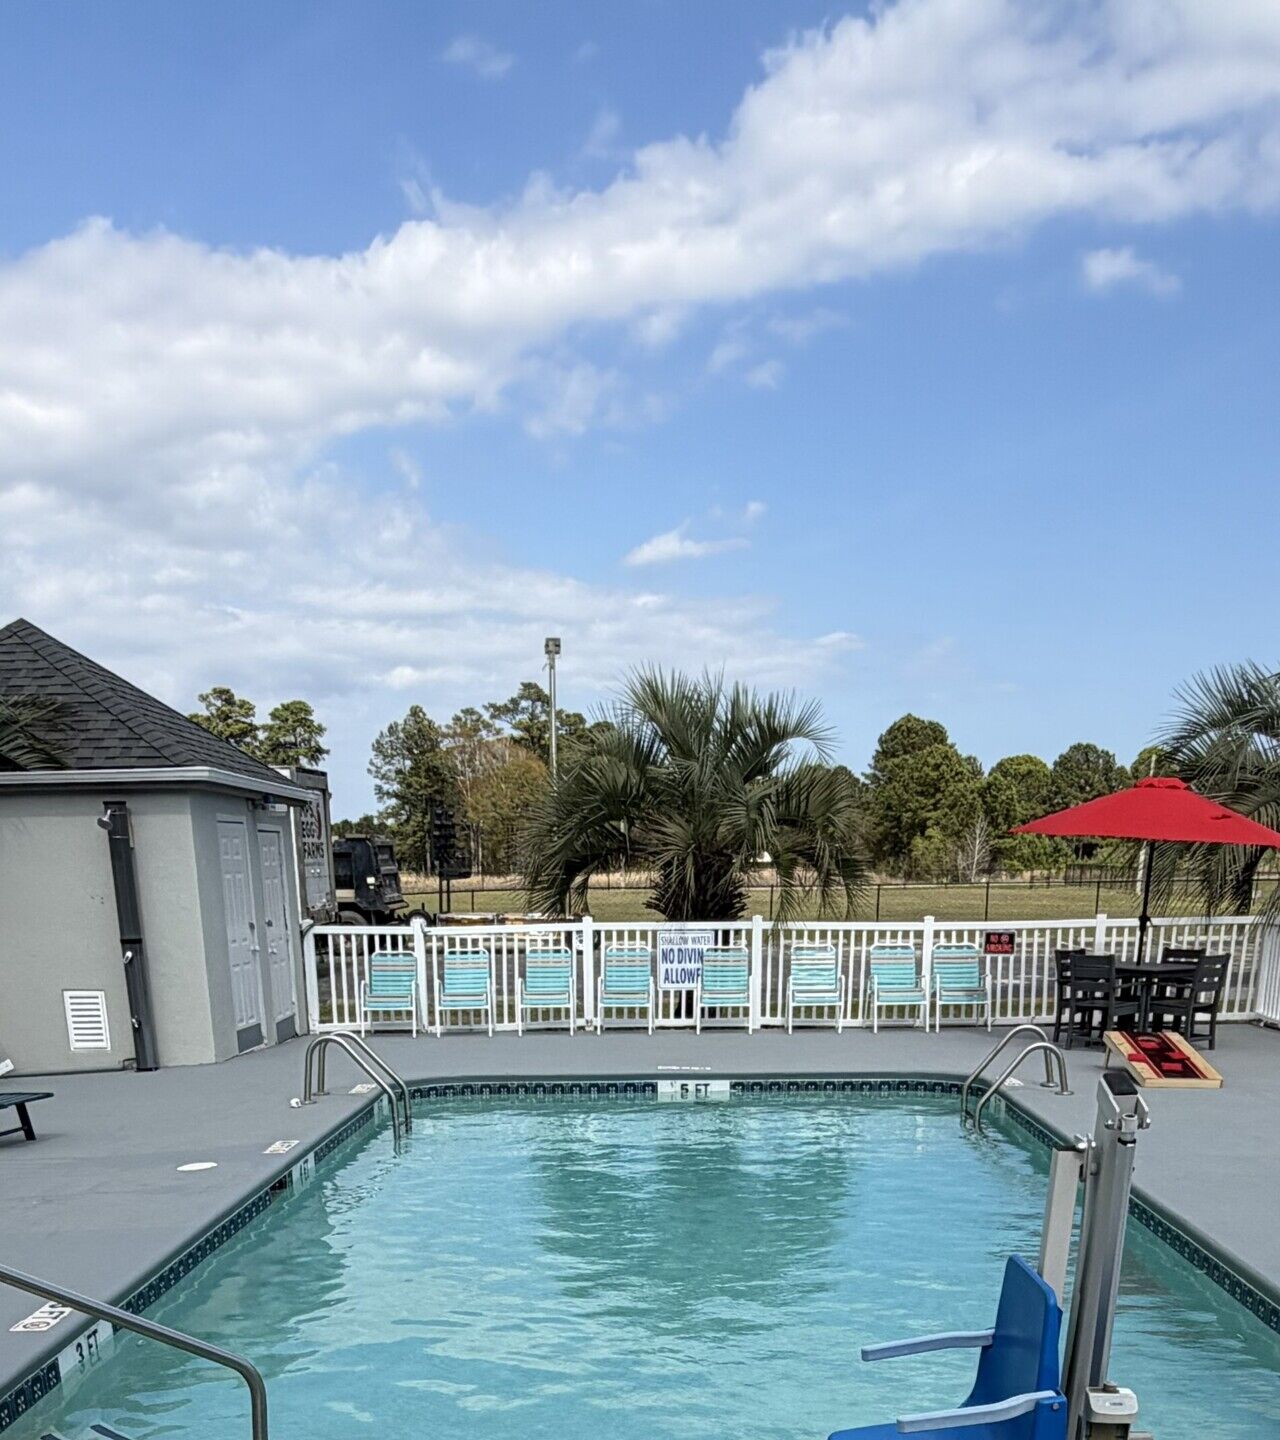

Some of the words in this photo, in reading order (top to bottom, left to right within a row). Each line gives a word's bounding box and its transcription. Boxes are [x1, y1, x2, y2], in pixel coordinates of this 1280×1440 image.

[661, 936, 690, 946] SHALLOW
[691, 936, 711, 946] WATER
[661, 948, 675, 964] NO
[677, 948, 704, 964] DIVIN
[75, 1342, 85, 1364] 3
